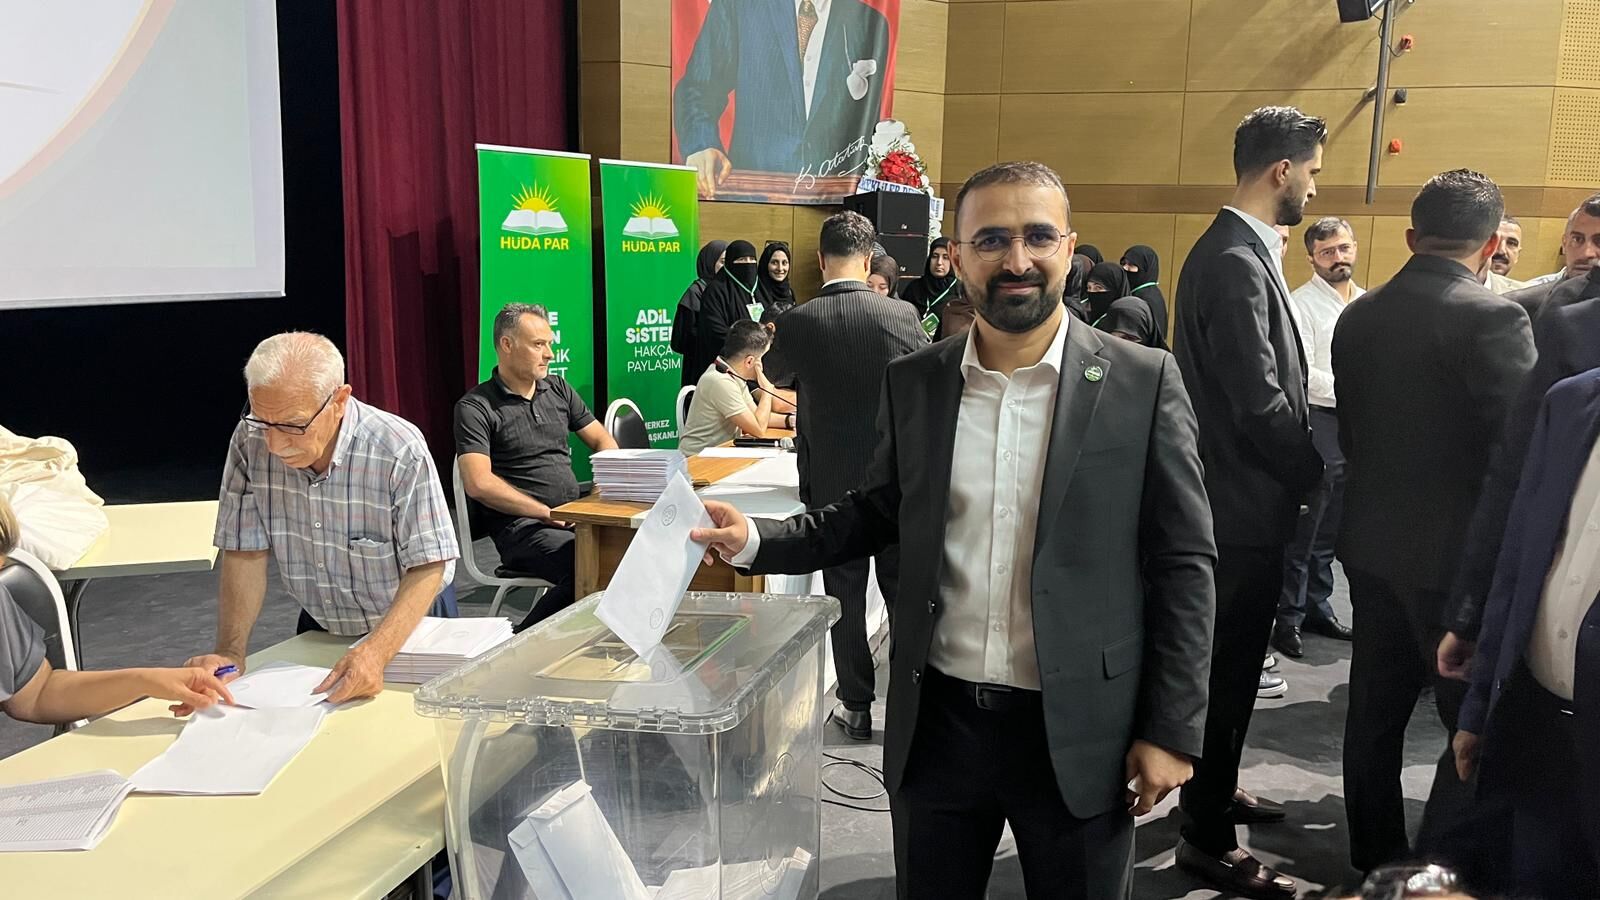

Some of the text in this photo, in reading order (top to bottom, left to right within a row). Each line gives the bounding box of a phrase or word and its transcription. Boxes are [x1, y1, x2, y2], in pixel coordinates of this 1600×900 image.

[500, 236, 569, 250] HÜDA PAR
[622, 240, 680, 253] HÜDA PAR
[634, 344, 673, 358] HAKÇA
[627, 358, 681, 372] PAYLAŞIM
